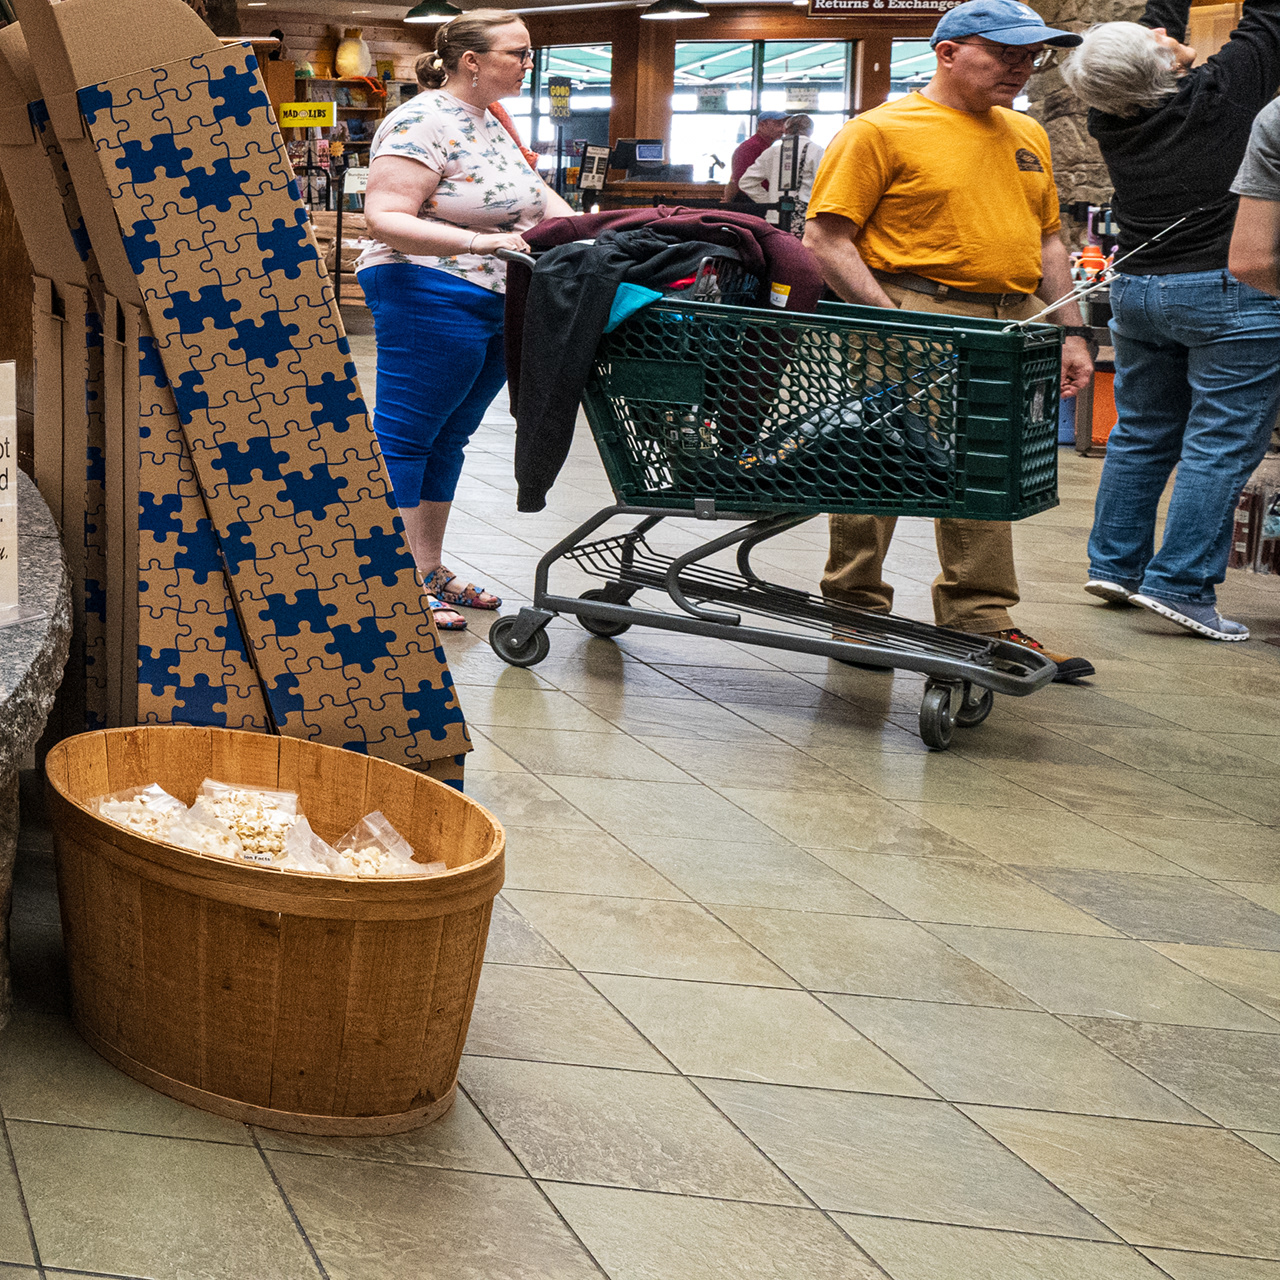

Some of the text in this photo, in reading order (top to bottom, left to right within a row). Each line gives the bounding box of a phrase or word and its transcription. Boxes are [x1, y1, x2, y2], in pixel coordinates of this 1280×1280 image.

[873, 0, 884, 8] &
[550, 85, 570, 97] GOOD
[283, 109, 327, 118] MAD LIBS
